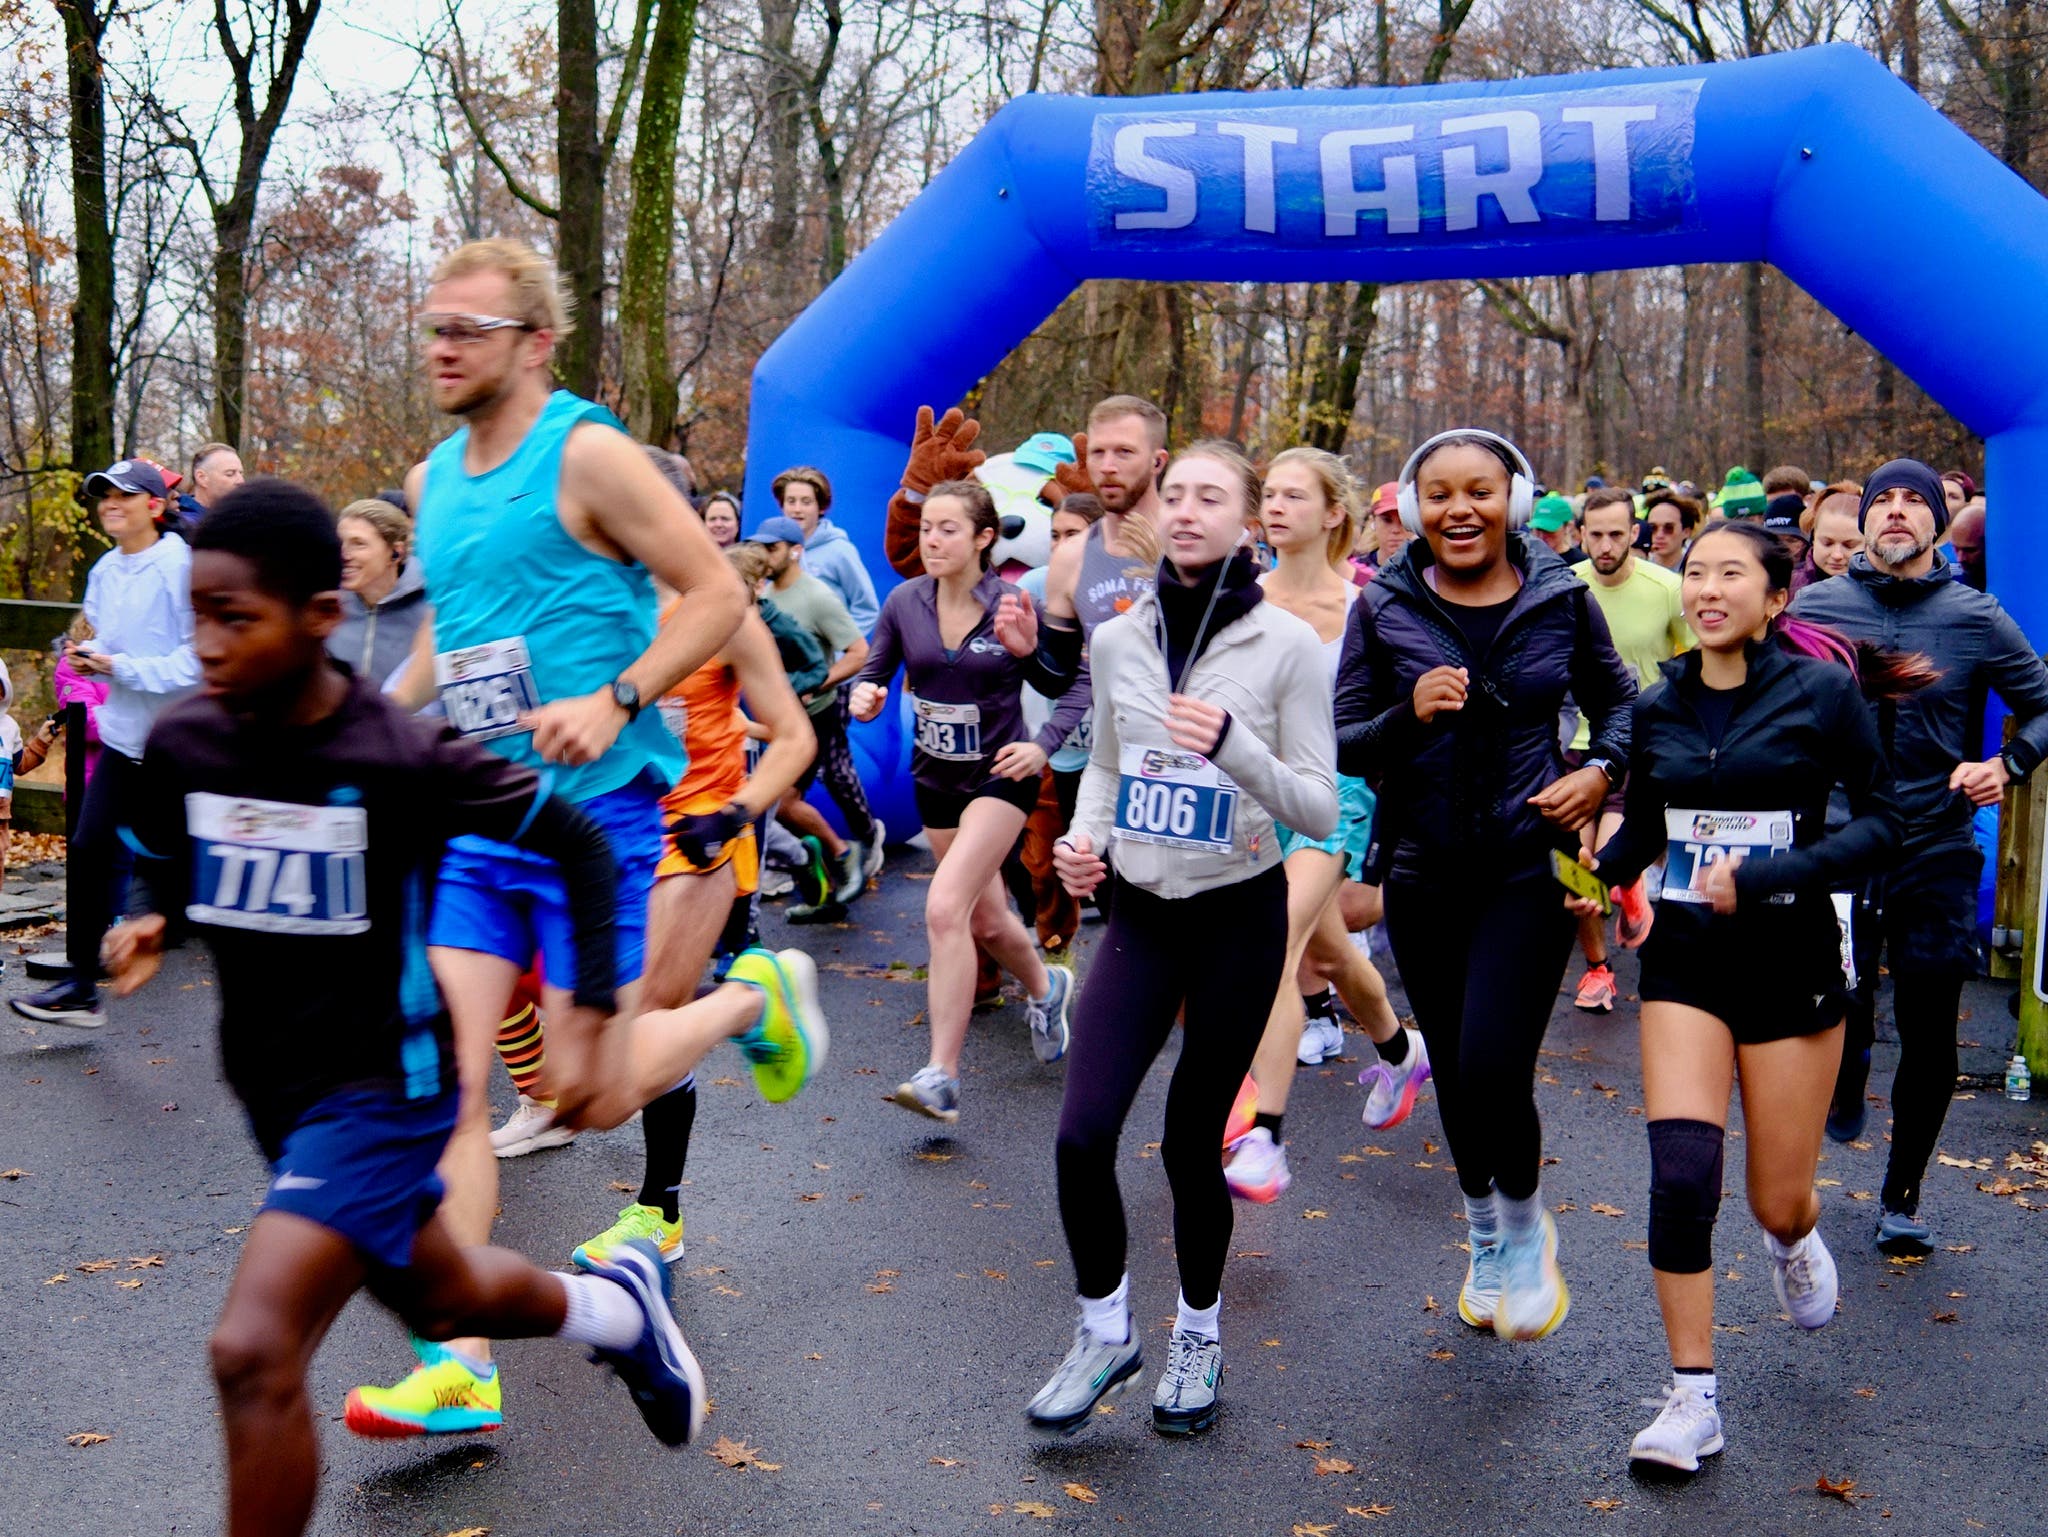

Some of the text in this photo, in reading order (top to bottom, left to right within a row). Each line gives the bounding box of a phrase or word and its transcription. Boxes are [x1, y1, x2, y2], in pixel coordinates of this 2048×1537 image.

[1114, 104, 1657, 236] START
[1087, 577, 1128, 604] SOMA
[1125, 780, 1199, 837] 806
[206, 843, 318, 917] 774
